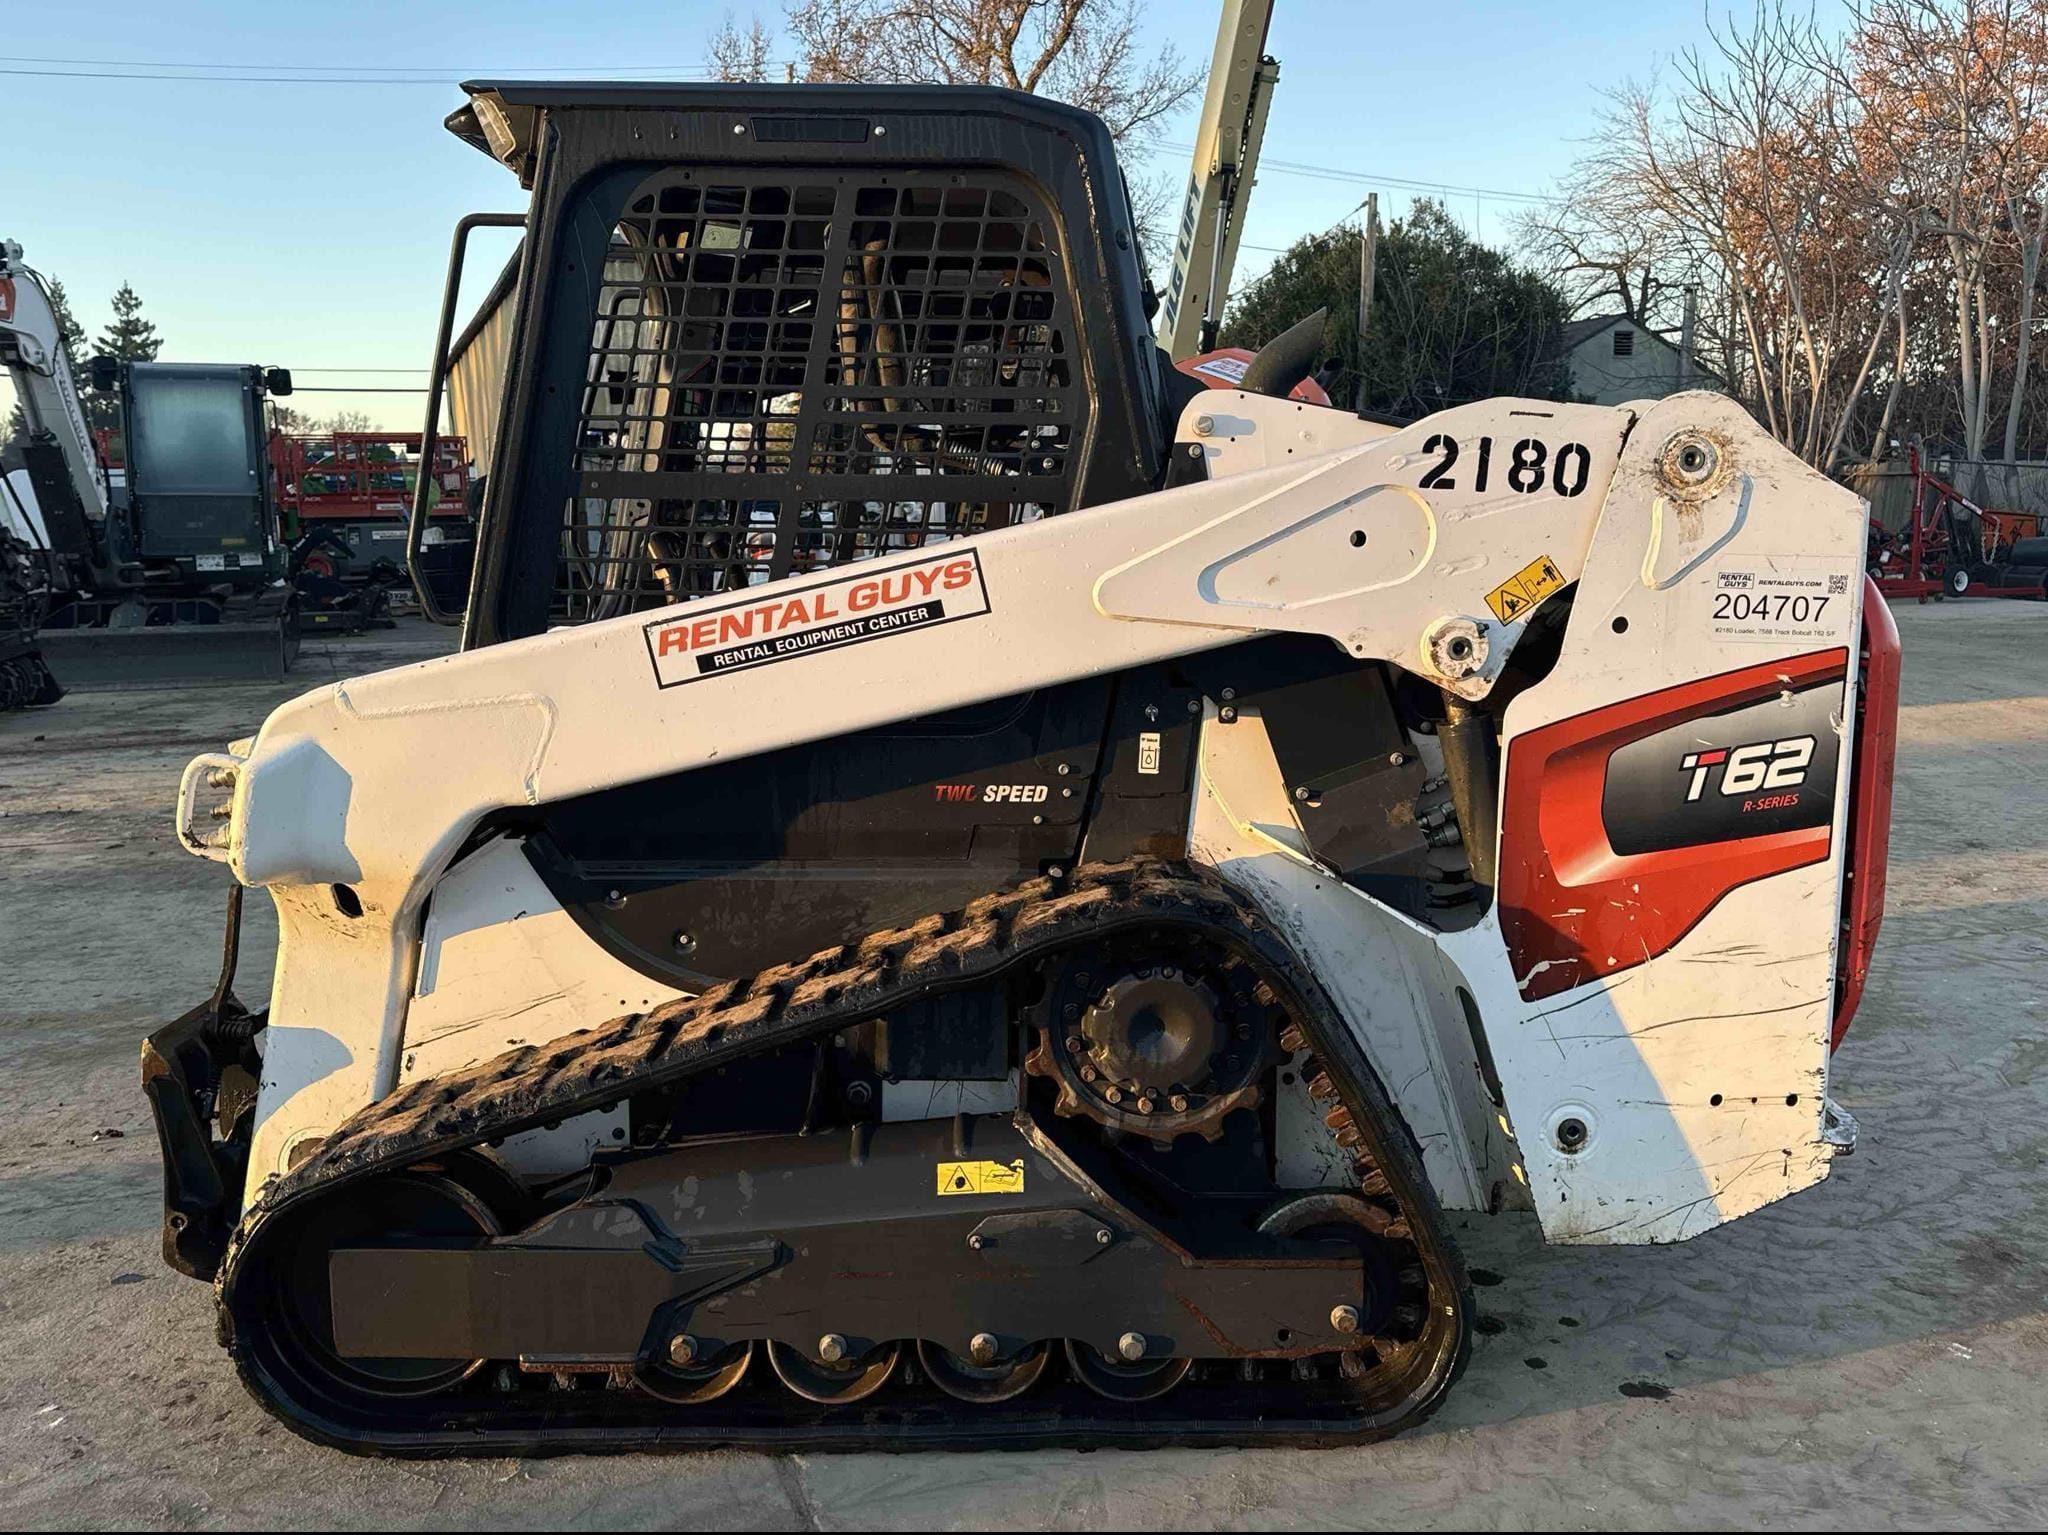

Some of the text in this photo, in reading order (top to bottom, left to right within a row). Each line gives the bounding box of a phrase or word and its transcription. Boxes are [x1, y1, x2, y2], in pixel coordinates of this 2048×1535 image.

[1165, 171, 1201, 337] JLG LIFT
[1419, 434, 1592, 498] 2180
[1713, 593, 1830, 622] 204707
[1720, 574, 1753, 582] RENTAL
[658, 560, 974, 657] RENTAL GUYS
[714, 607, 930, 667] RENTAL EQUIPMENT CENTER
[983, 785, 1049, 803] SPEED
[1682, 738, 1814, 802] T62
[1743, 793, 1800, 813] R-SERIES
